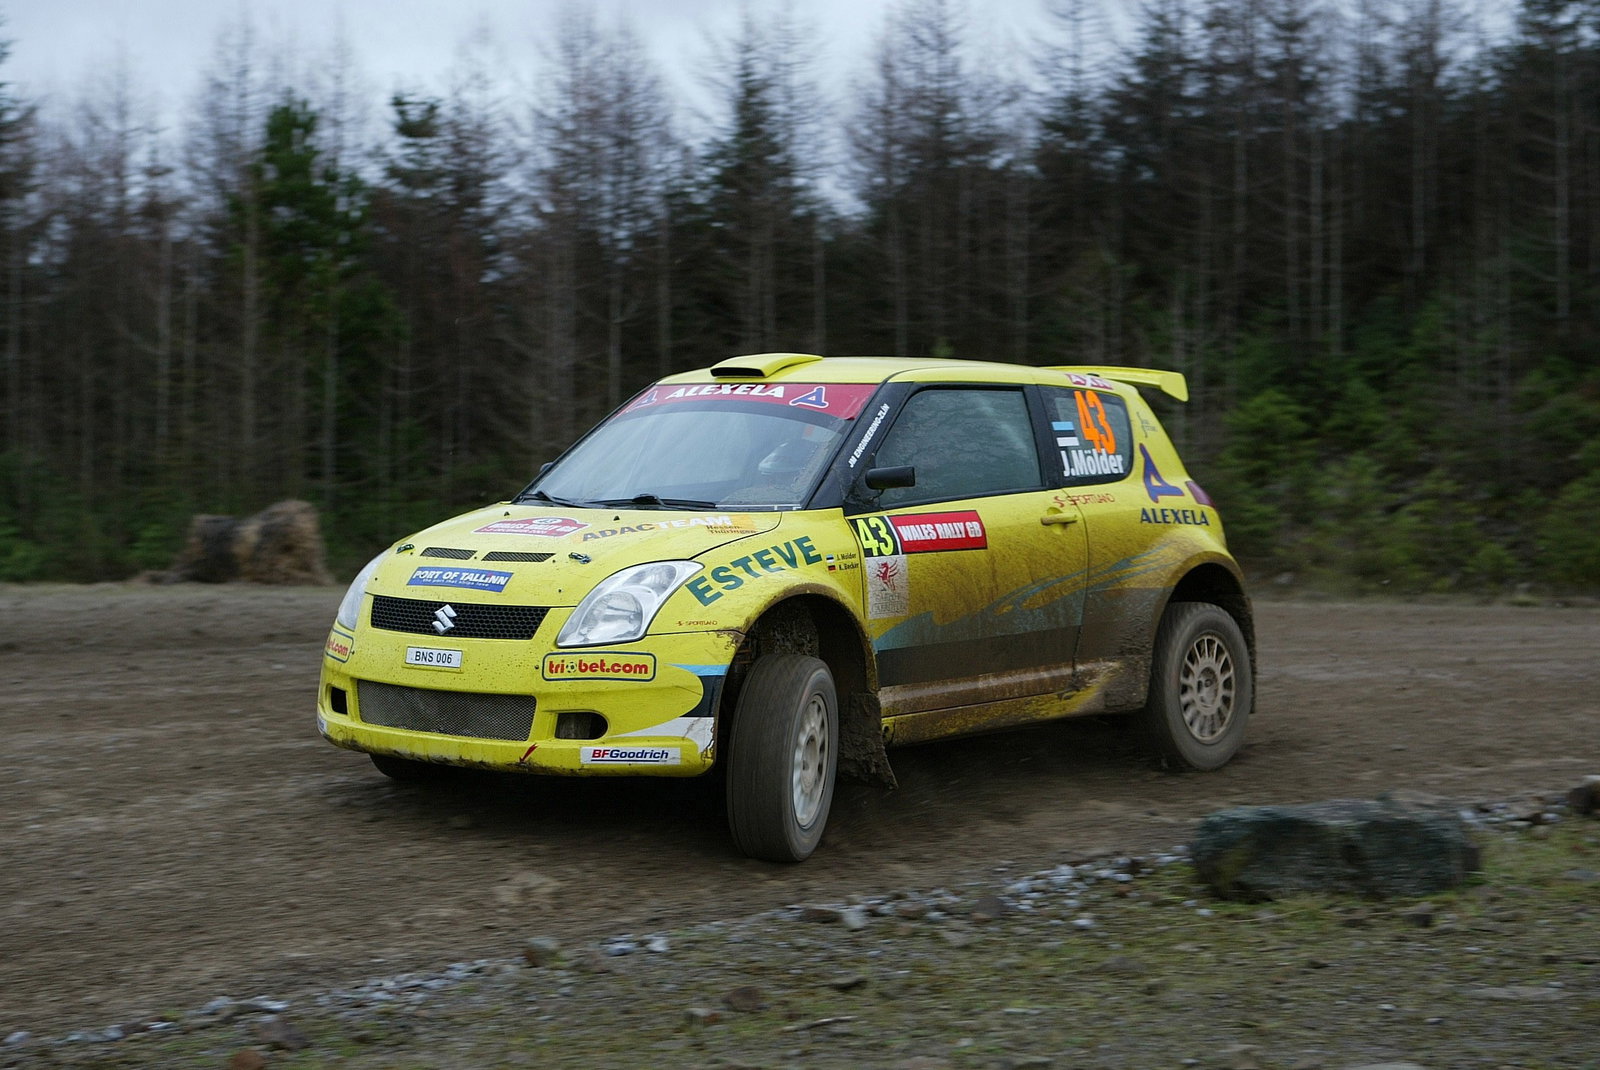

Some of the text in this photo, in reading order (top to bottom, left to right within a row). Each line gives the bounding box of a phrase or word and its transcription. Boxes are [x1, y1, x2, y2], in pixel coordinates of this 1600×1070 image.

[665, 384, 785, 399] ALEXELA
[1074, 390, 1116, 454] 43
[1060, 448, 1125, 477] J.Mölder
[1140, 507, 1210, 526] ALEXELA
[856, 516, 894, 556] 43
[897, 521, 983, 541] WALES RALLY GB
[412, 570, 442, 579] PORT
[442, 571, 460, 580] OF
[685, 535, 823, 607] ESTEVE
[414, 651, 453, 664] BNS 006
[592, 749, 669, 759] BFGoodrich
